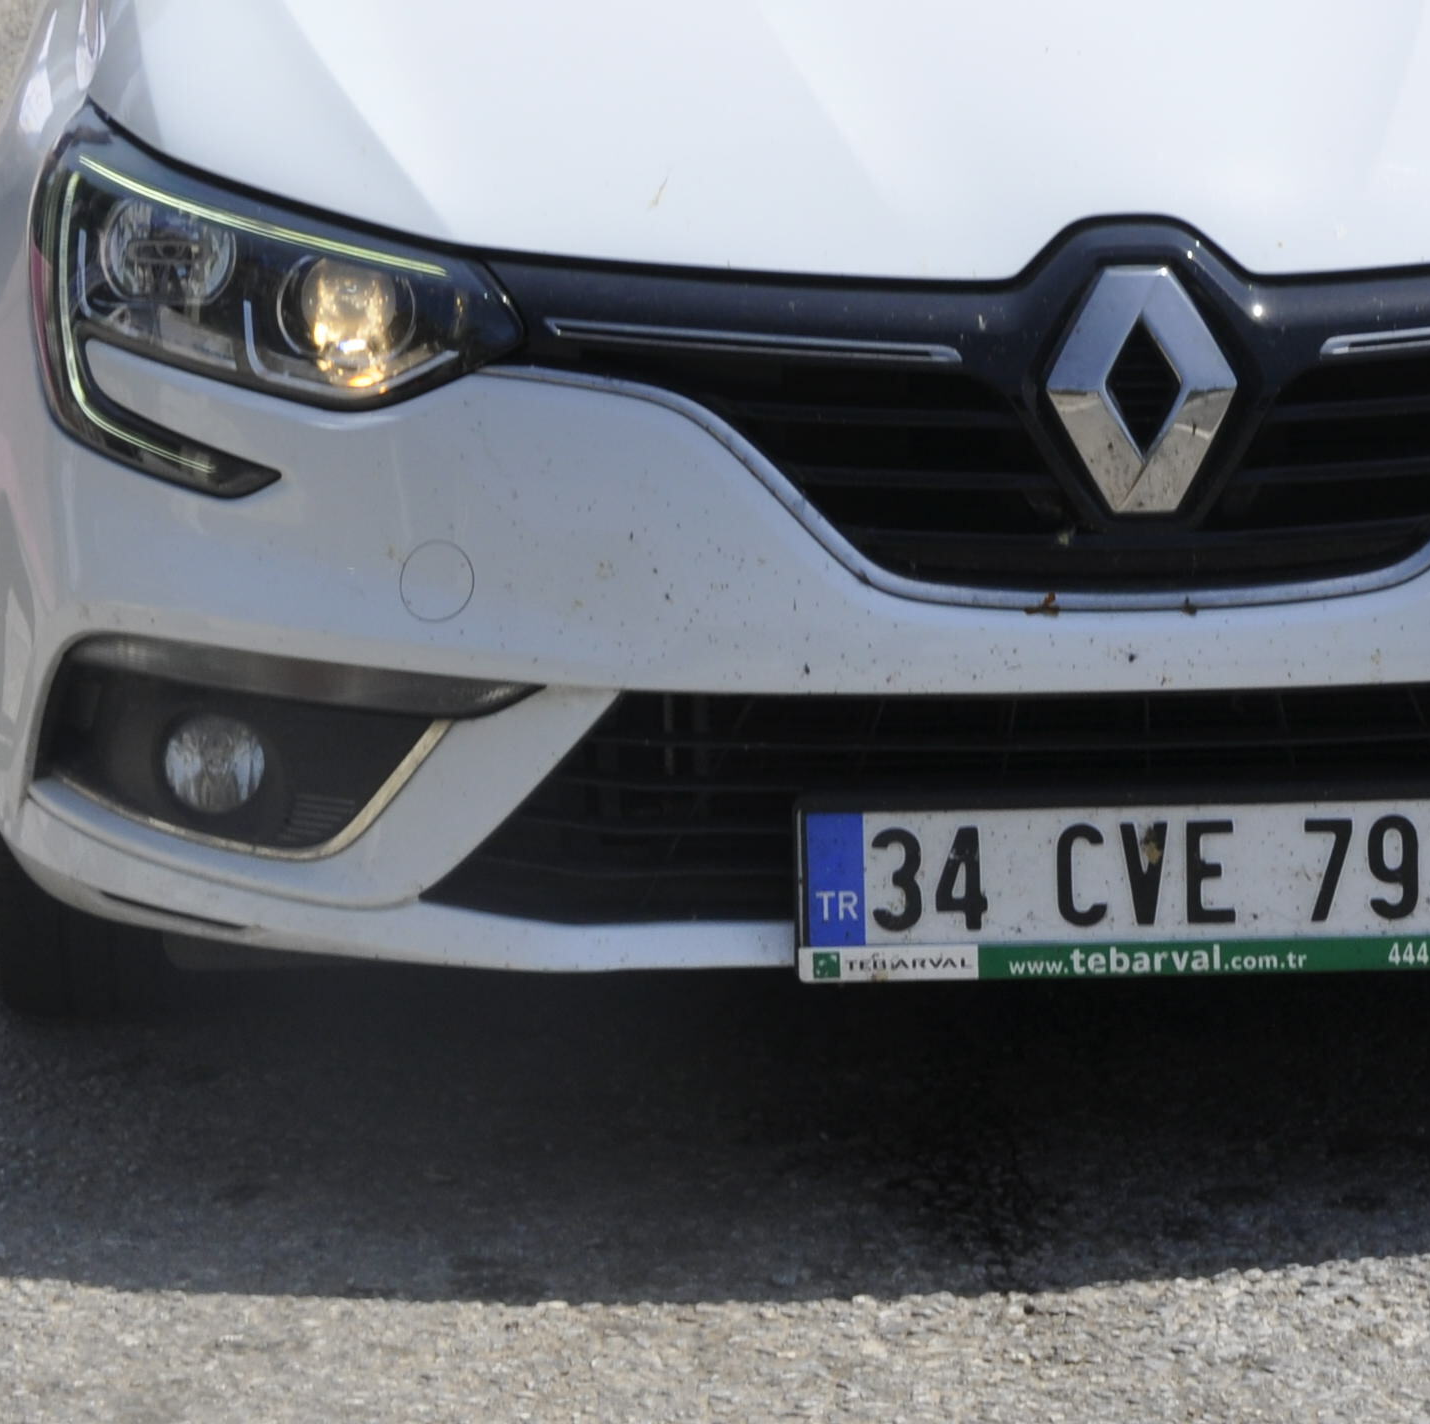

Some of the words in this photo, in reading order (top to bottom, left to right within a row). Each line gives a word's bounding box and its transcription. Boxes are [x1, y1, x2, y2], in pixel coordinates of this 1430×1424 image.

[872, 827, 988, 932] 34
[1057, 821, 1236, 927] CVE
[815, 890, 859, 922] TR
[1009, 943, 1307, 974] www.tebarval.com.tr
[1388, 941, 1430, 965] 444
